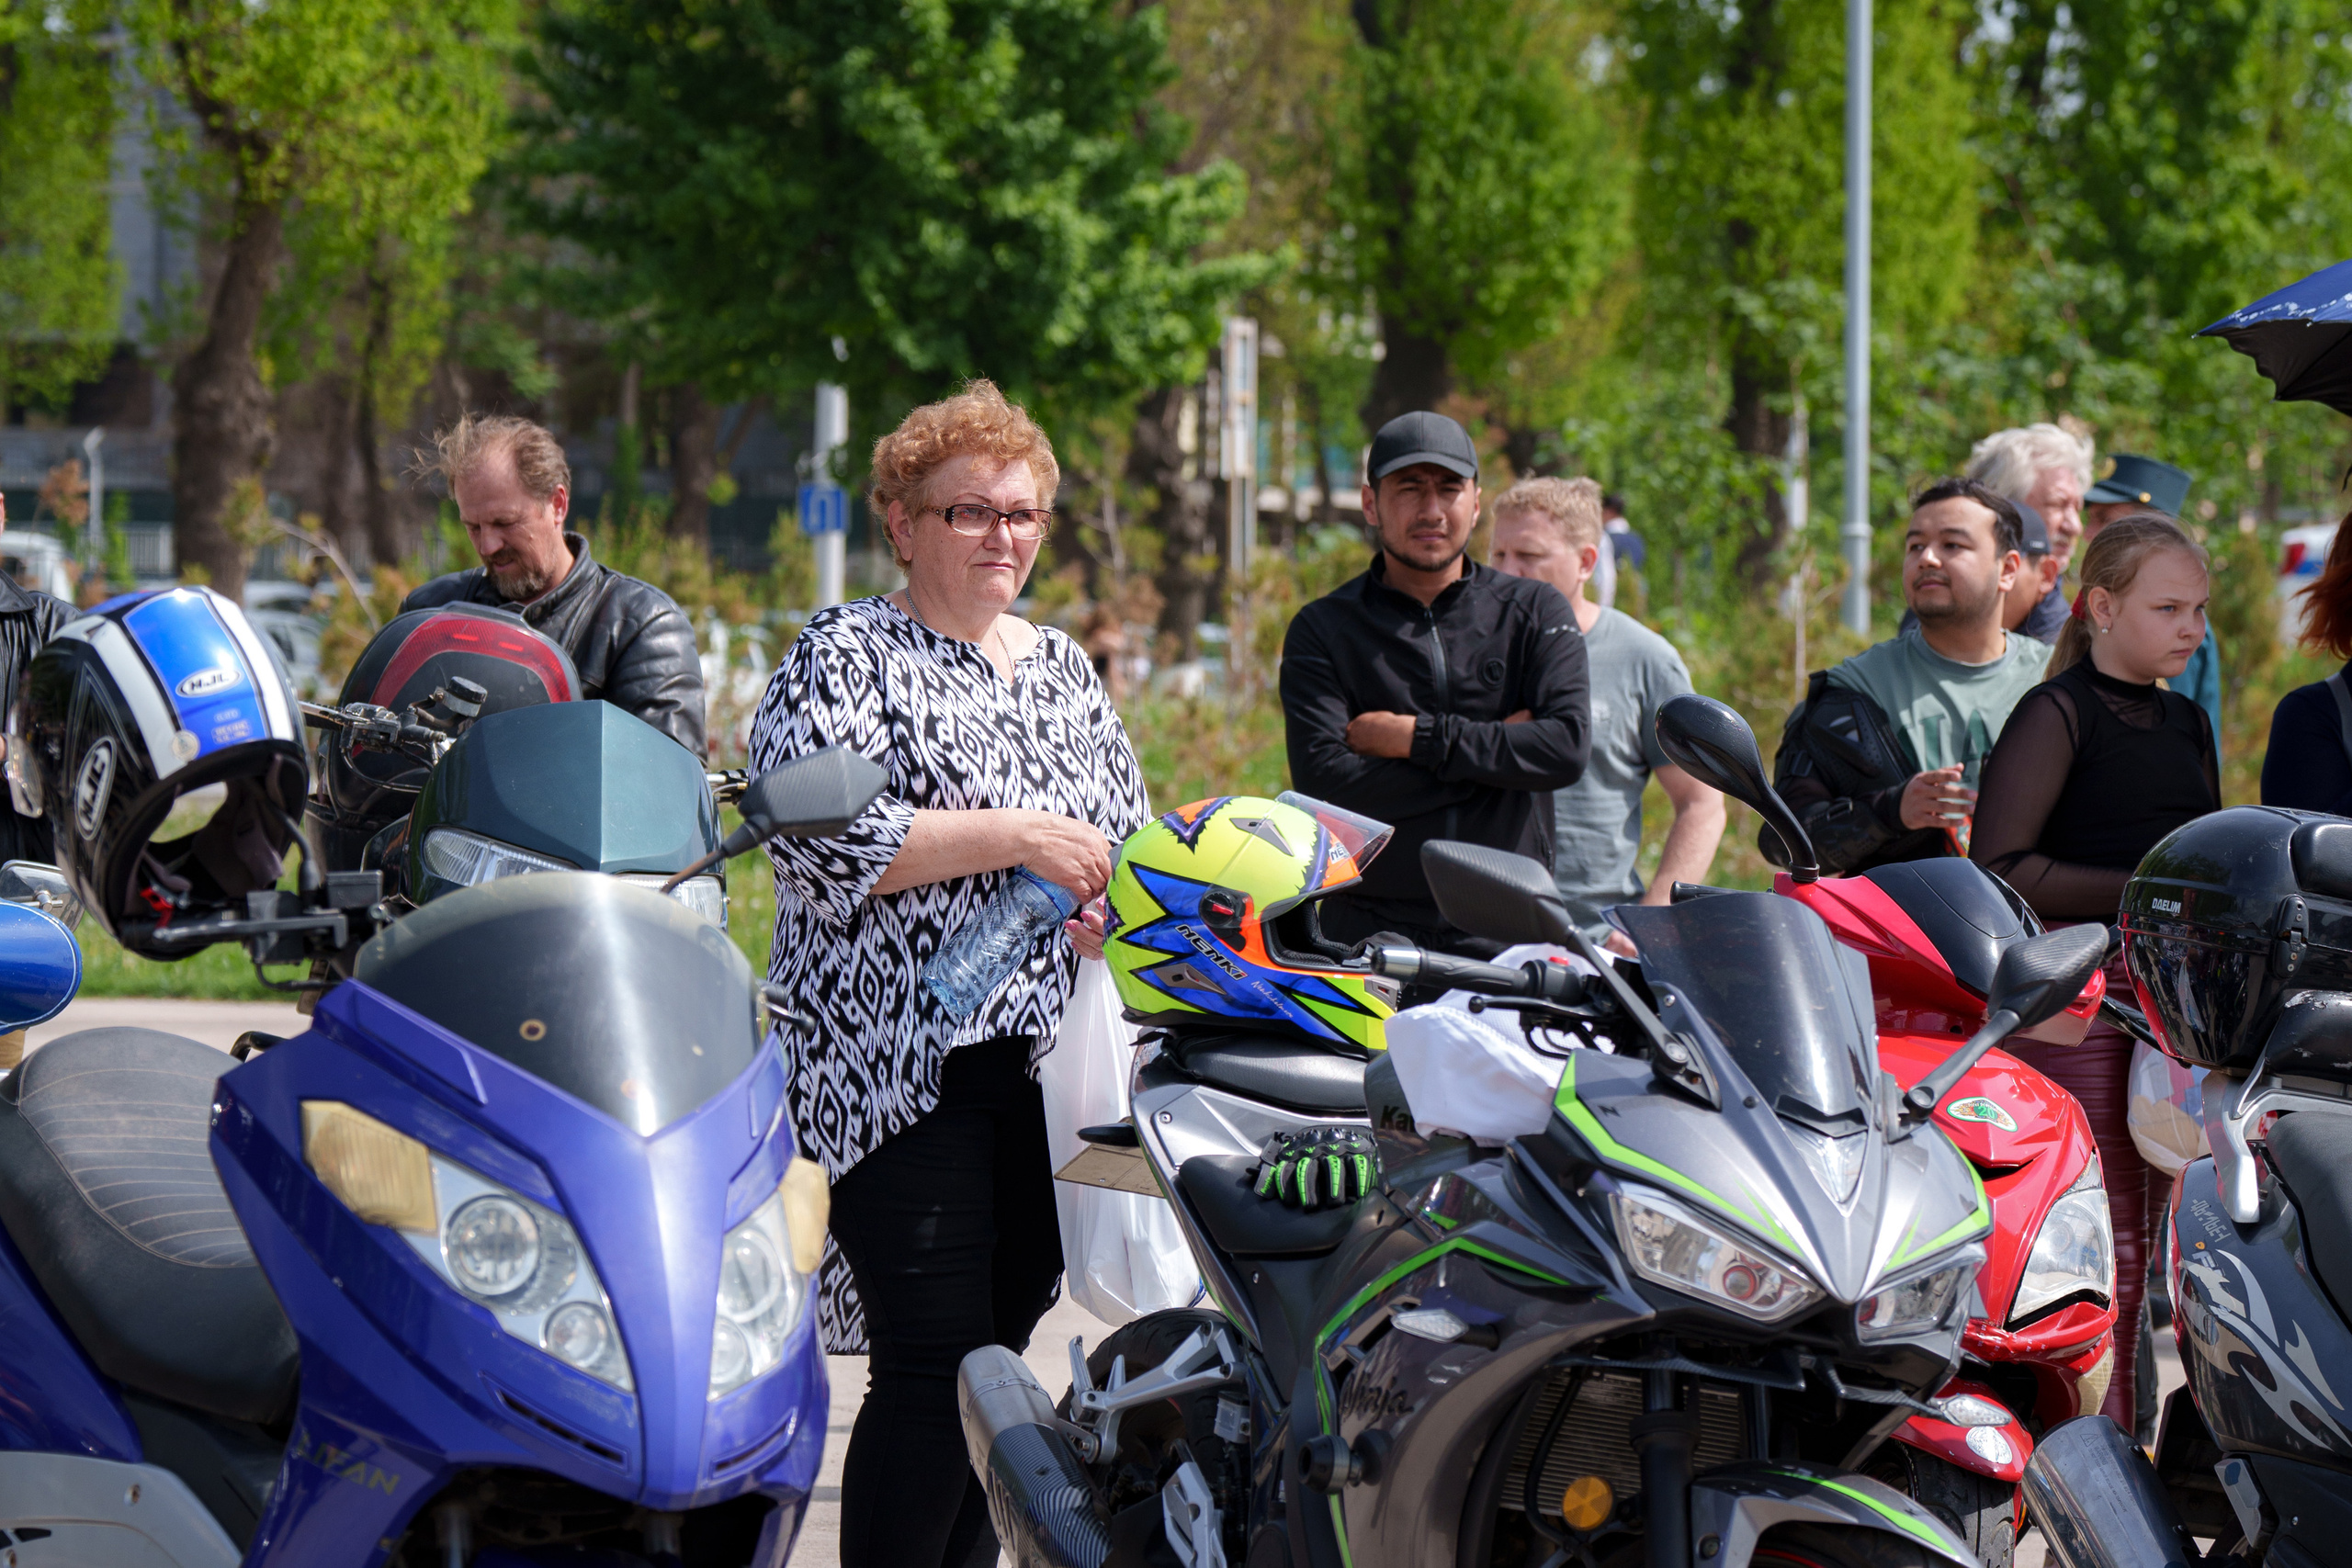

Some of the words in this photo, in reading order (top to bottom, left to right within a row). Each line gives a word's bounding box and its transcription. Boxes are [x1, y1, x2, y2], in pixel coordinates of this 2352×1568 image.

[81, 753, 106, 824] HJC
[2152, 897, 2181, 914] DAELIM
[1977, 1106, 1996, 1120] 20
